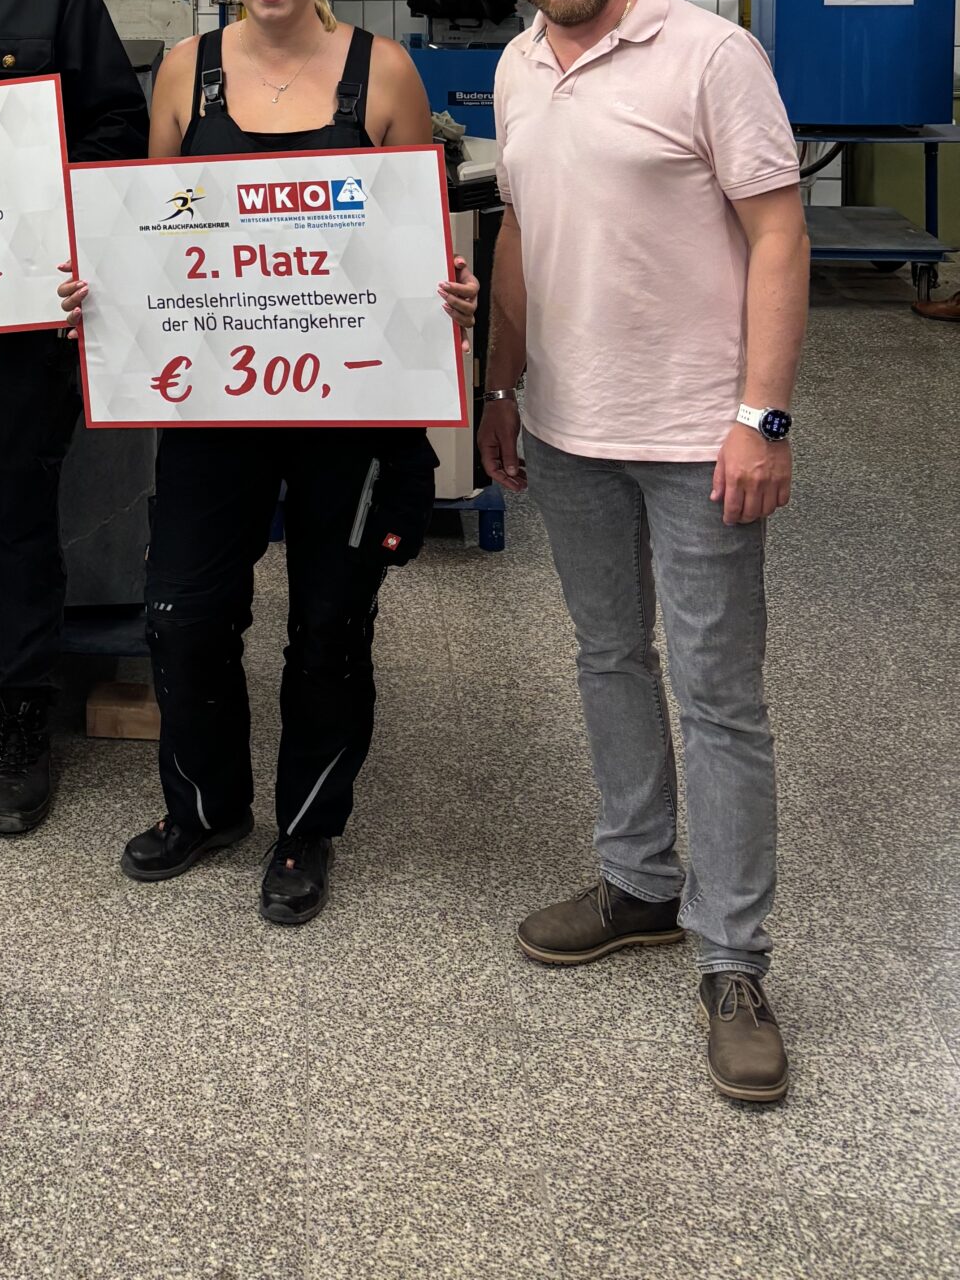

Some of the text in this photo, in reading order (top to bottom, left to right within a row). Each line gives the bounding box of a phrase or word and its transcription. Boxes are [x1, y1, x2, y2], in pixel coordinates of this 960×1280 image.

[239, 184, 326, 210] WKO
[163, 222, 230, 231] RAUCHFANGKEHRER
[240, 213, 366, 224] WIRTSCHAFTSKAMMER NIEDERÖSTERREICH
[307, 220, 366, 229] Rauchfangkehrer
[185, 244, 330, 280] 2. Platz
[147, 289, 377, 311] Landeslehrlingswettbewerb
[161, 313, 366, 334] der NÖ Rauchfangkehrer
[150, 355, 193, 403] €
